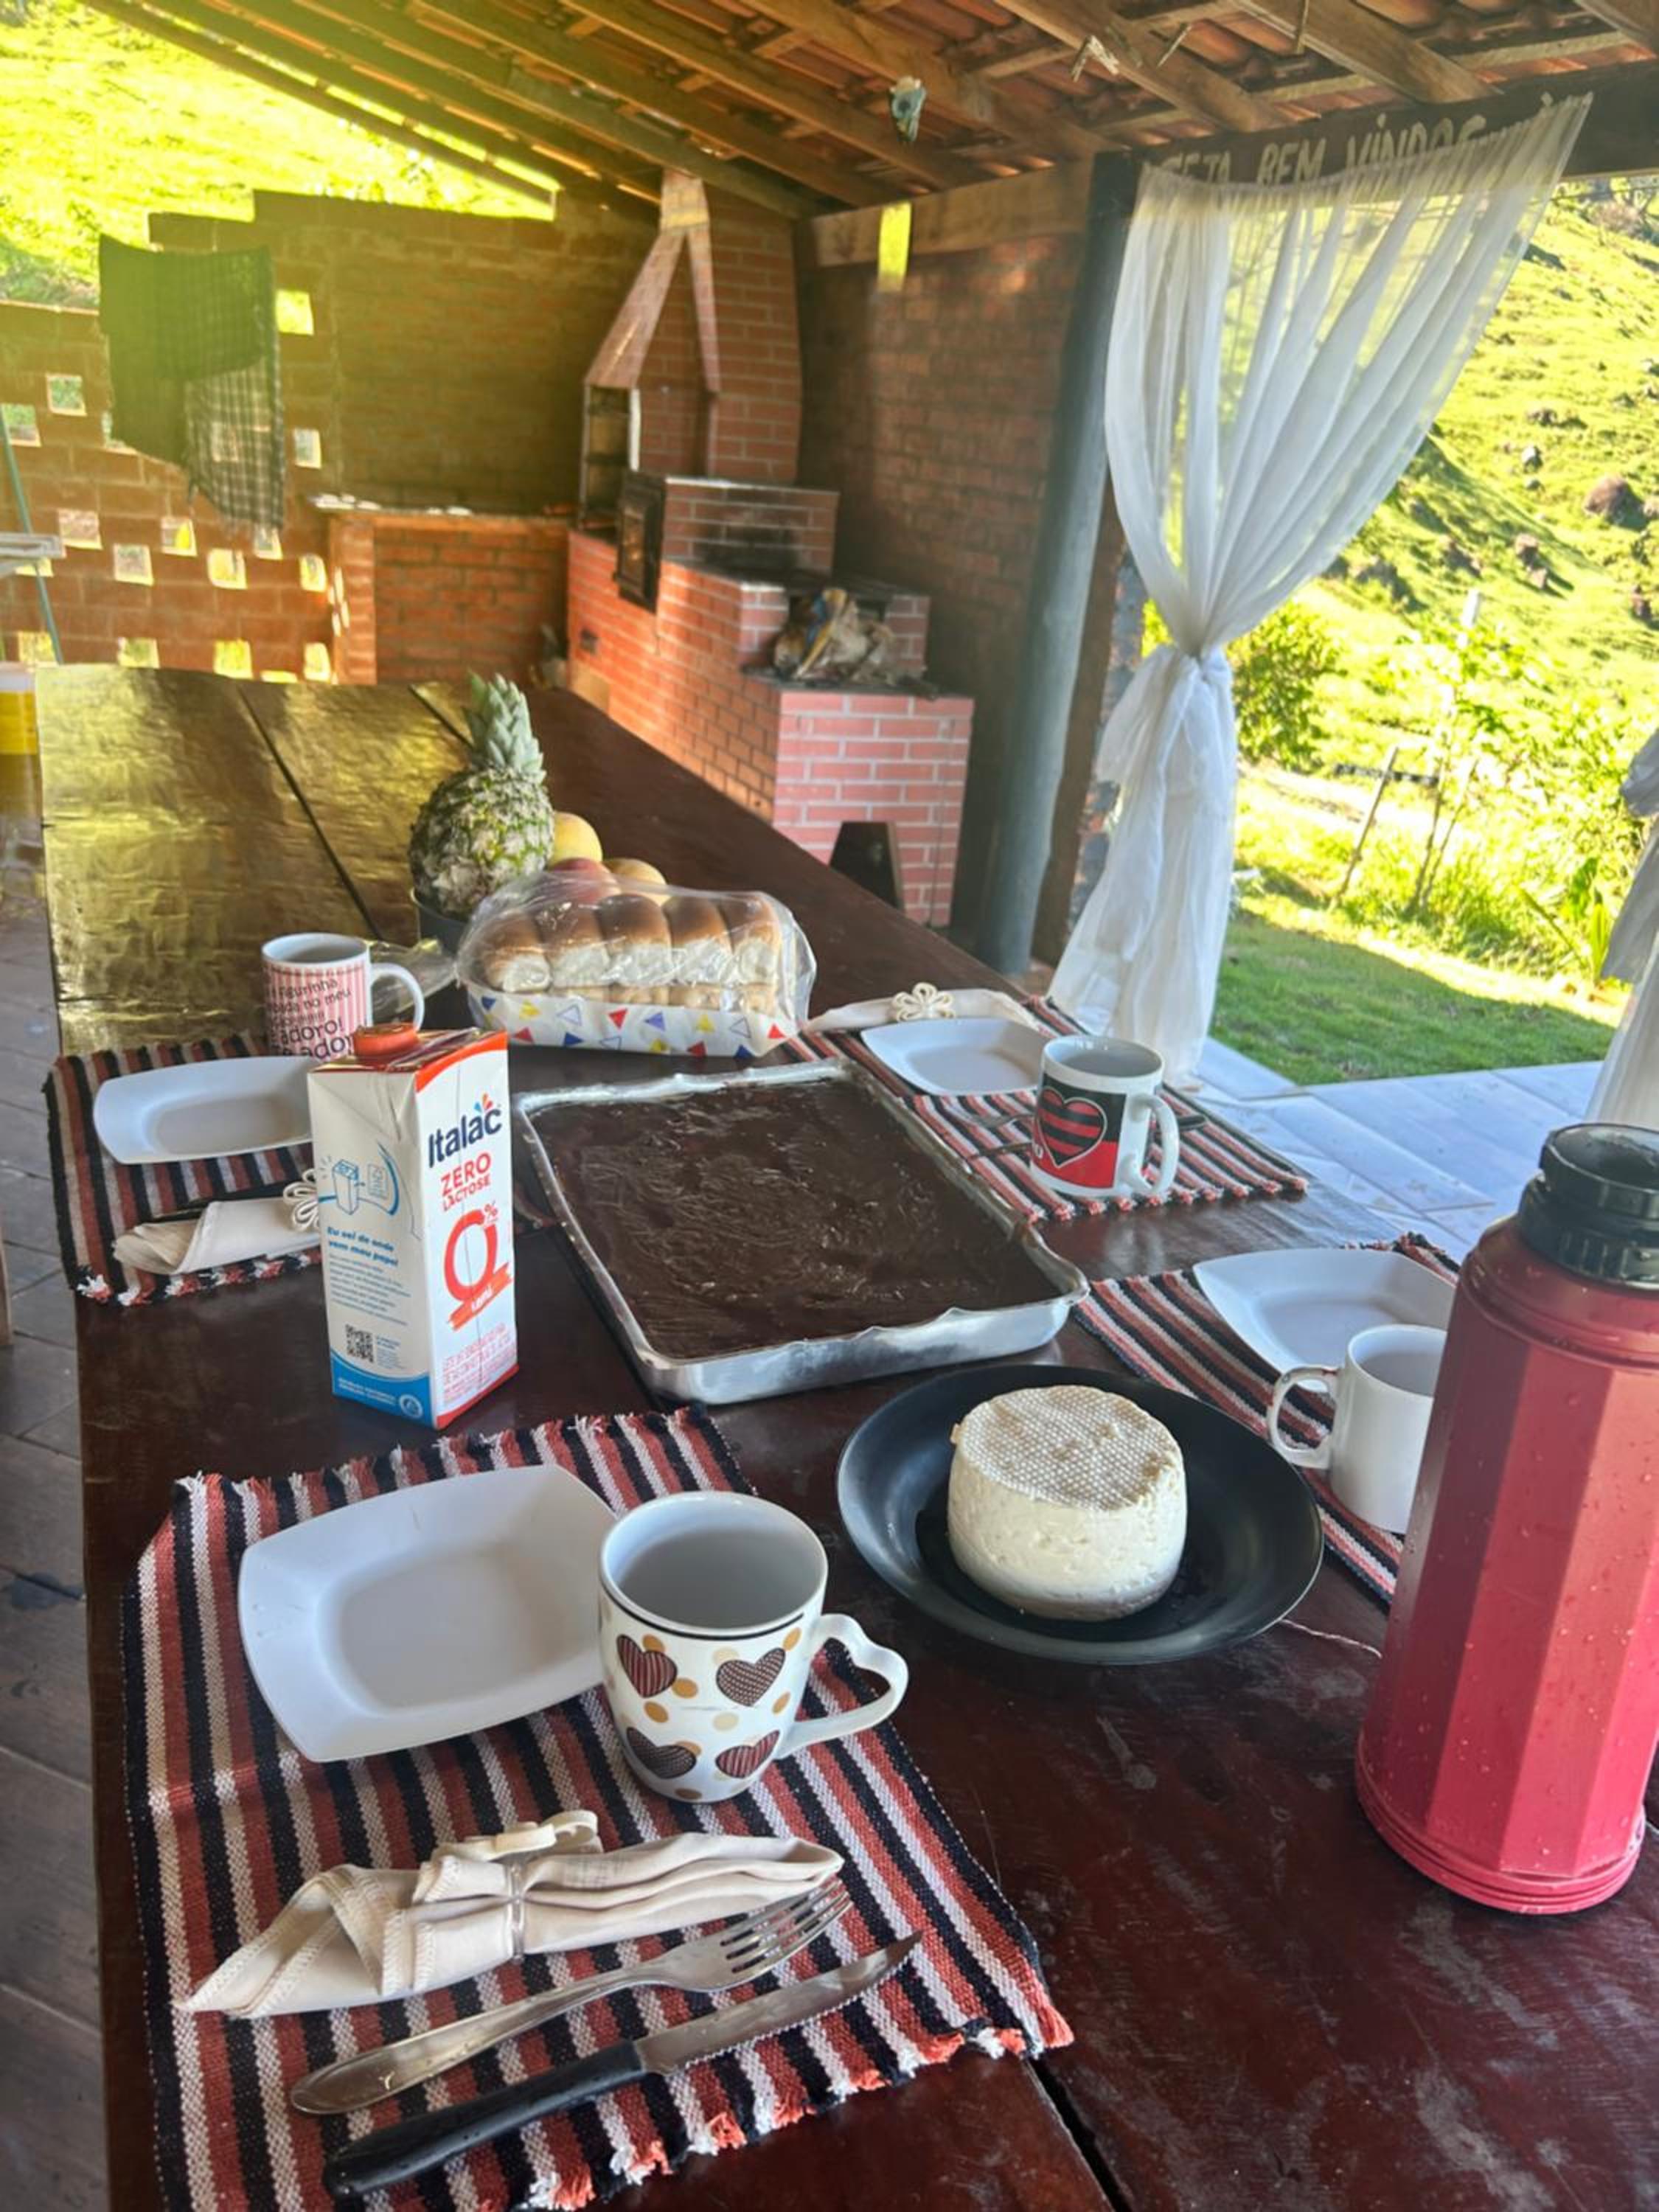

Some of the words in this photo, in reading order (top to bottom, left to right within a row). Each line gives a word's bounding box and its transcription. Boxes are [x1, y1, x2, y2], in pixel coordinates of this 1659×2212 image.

[429, 1108, 502, 1168] Italac
[441, 1152, 491, 1197] ZERO
[443, 1175, 492, 1212] LACTOSE
